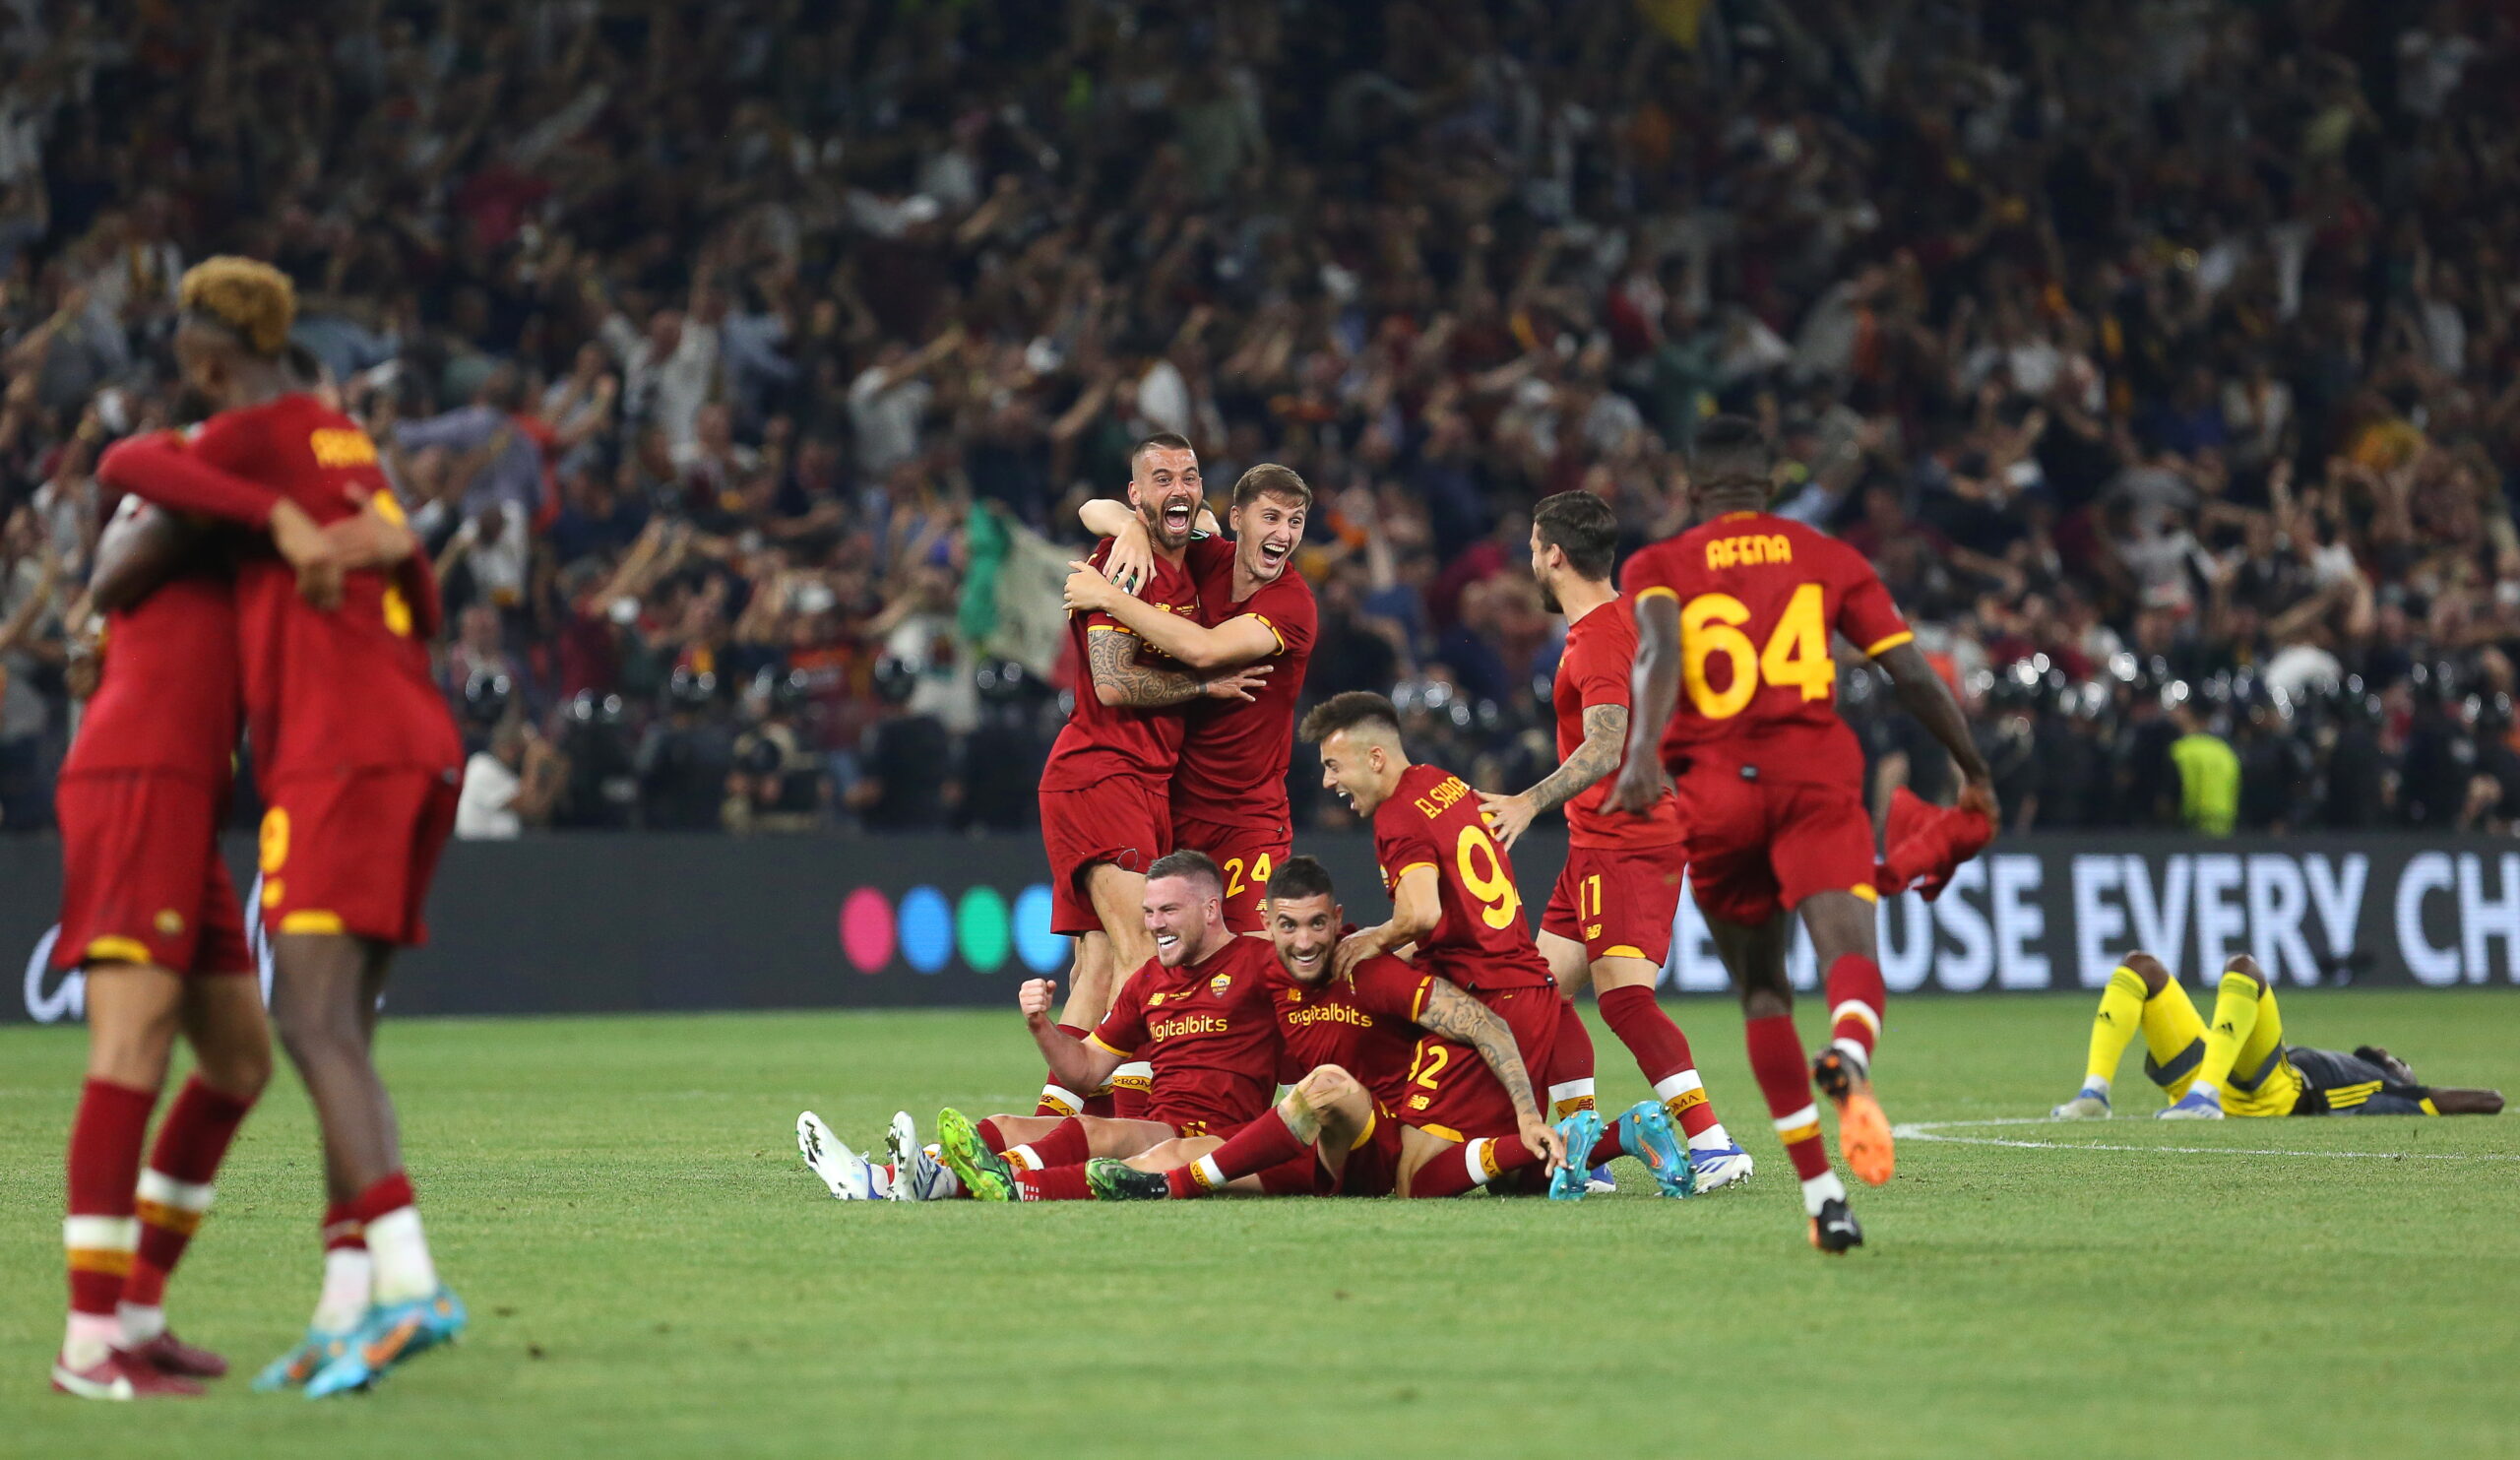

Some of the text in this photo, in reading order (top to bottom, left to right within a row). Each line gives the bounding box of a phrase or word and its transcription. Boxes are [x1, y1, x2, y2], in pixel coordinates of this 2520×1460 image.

[1706, 534, 1793, 571] AFENA
[1680, 583, 1836, 720] 64
[1414, 797, 1443, 819] EL
[1224, 853, 1271, 899] 24
[1457, 812, 1522, 929] 9
[2071, 852, 2368, 987] EVERY
[2393, 851, 2520, 986] CH
